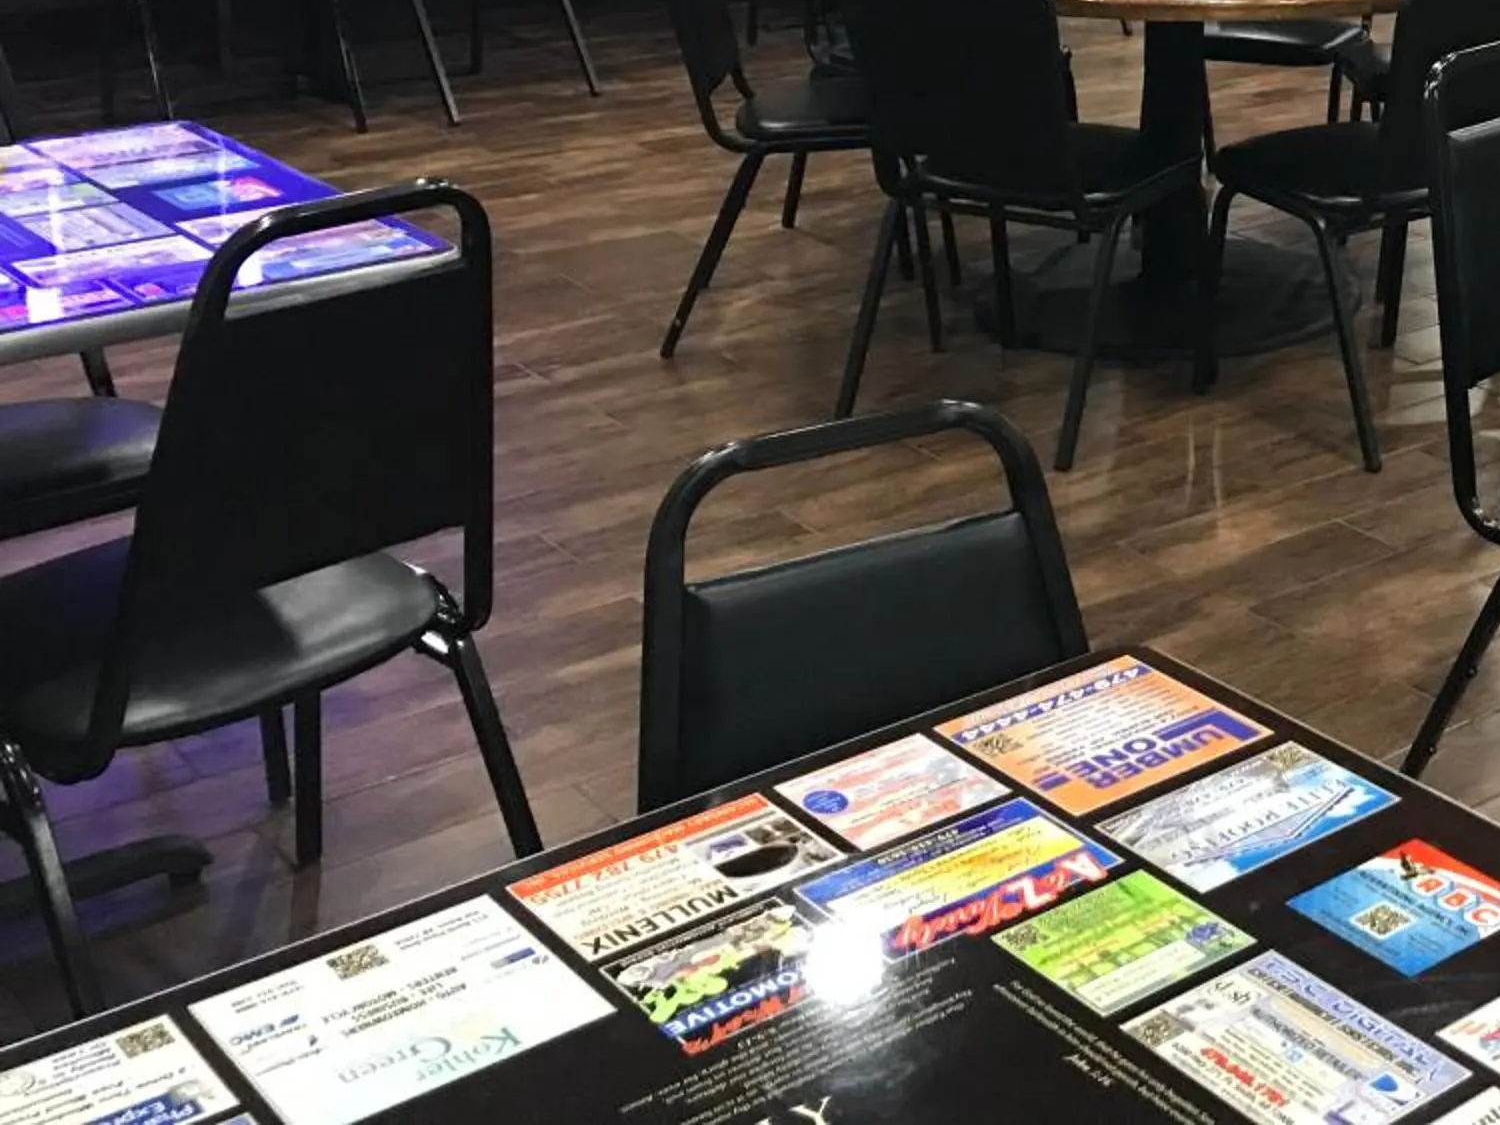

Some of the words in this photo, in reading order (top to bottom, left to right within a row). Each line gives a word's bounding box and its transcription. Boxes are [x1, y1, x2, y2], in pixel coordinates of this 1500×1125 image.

[1064, 735, 1161, 778] ONE
[579, 884, 741, 955] MULLENIX
[404, 966, 459, 990] RENTERS
[227, 1023, 277, 1046] EMC
[403, 1026, 524, 1084] Kohler
[334, 1031, 458, 1092] Green
